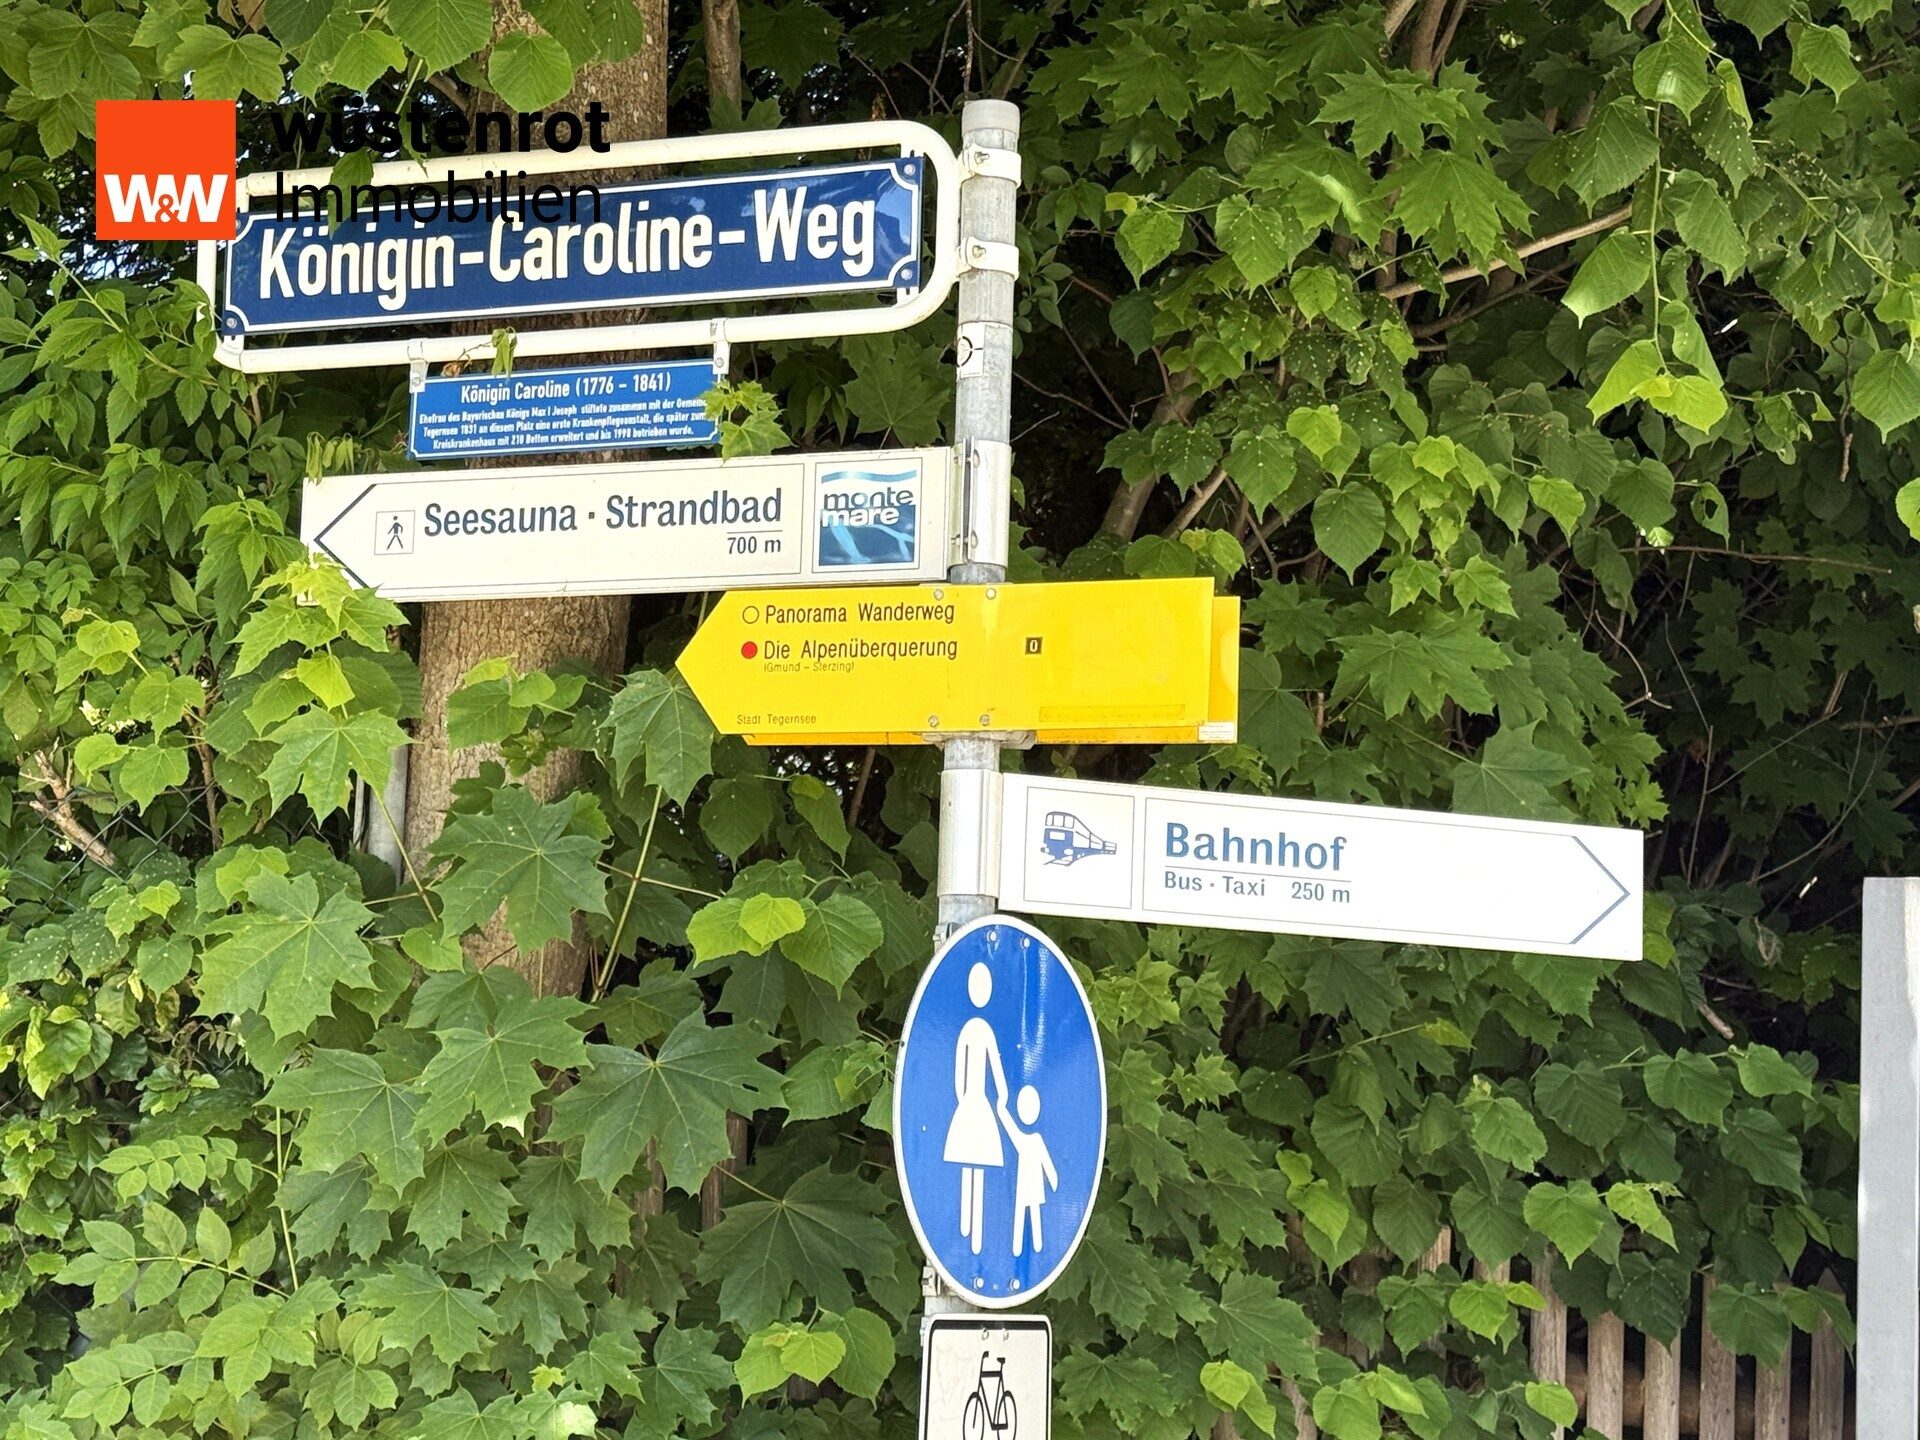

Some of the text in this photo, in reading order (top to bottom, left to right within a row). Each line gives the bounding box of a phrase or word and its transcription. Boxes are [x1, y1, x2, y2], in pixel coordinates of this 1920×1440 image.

[259, 186, 876, 312] Königin-Caroline-Weg
[461, 383, 510, 405] Königin
[515, 379, 570, 399] Caroline
[576, 376, 614, 397] (1776
[633, 372, 671, 392] 1841)
[419, 412, 446, 424] Ehefrau
[448, 411, 460, 422] des
[462, 409, 504, 423] Bayerischen
[506, 407, 530, 420] Königs
[532, 406, 546, 417] Max
[552, 405, 577, 417] Joseph
[581, 403, 607, 414] stiftete
[608, 401, 646, 413] zusammen
[649, 399, 660, 411] mit
[662, 399, 675, 409] der
[423, 426, 458, 439] Tegernsee
[480, 425, 488, 434] an
[490, 423, 514, 433] diesem
[516, 420, 534, 431] Platz
[536, 420, 550, 430] eine
[552, 419, 571, 429] erste
[653, 413, 664, 423] die
[666, 412, 690, 425] später
[433, 438, 495, 450] Kreiskrankenhaus
[498, 435, 509, 446] mit
[511, 434, 524, 445] 210
[526, 433, 549, 444] Betten
[550, 431, 583, 443] erweitert
[585, 430, 599, 441] und
[600, 429, 612, 440] bis
[633, 427, 667, 438] betrieben
[669, 425, 694, 436] wurde.
[823, 486, 914, 510] monte
[423, 502, 577, 537] Seesauna
[605, 487, 782, 529] Strandbad
[821, 507, 900, 527] mare
[727, 536, 782, 555] 700 m
[765, 602, 955, 625] Panorama Wanderweg
[764, 638, 958, 662] Die Alpenüberquerung
[764, 661, 801, 673] (Gmund
[813, 661, 855, 674] Sterzing)
[736, 714, 817, 727] Stadt Tegernsee
[1165, 822, 1348, 871] Bahnhof
[1164, 871, 1203, 892] Bus
[1222, 875, 1266, 897] Taxi
[1291, 882, 1325, 902] 250
[1332, 887, 1351, 904] m
